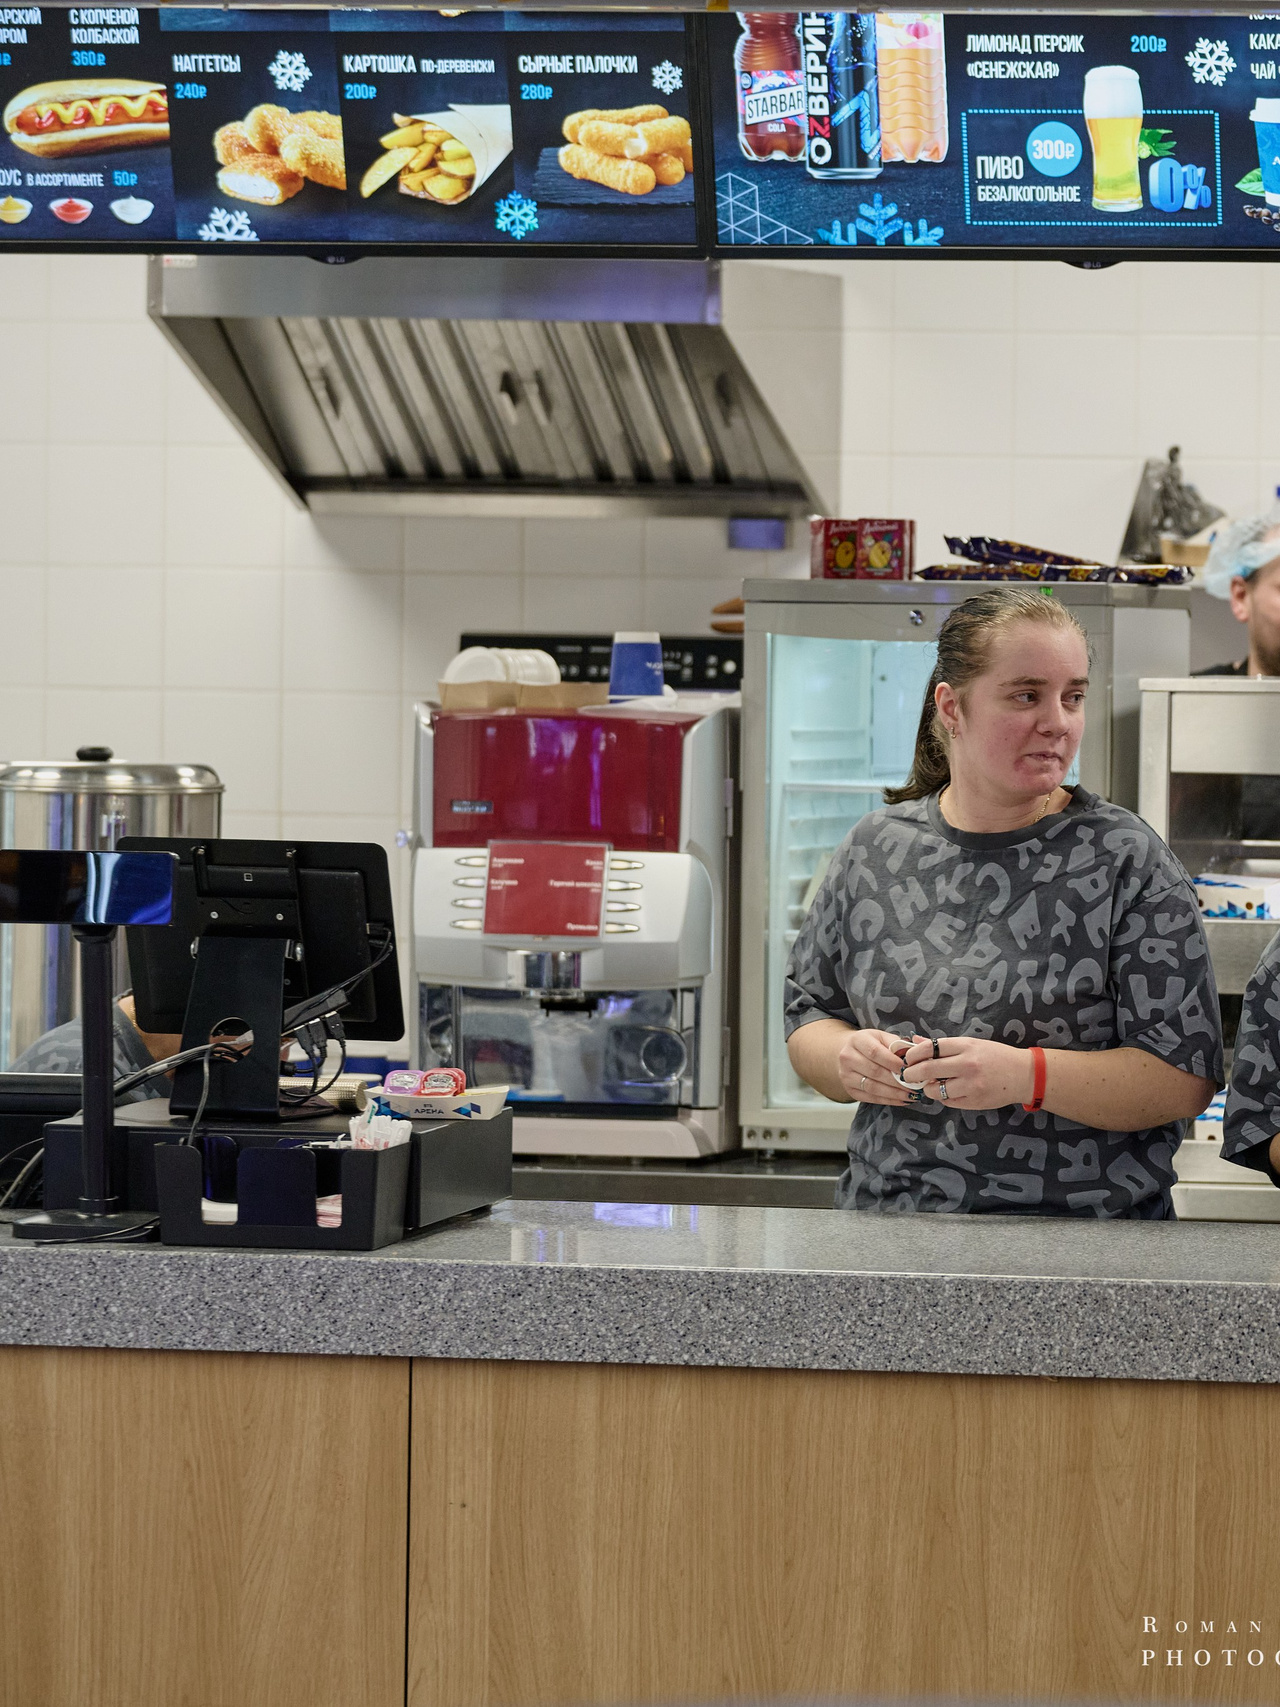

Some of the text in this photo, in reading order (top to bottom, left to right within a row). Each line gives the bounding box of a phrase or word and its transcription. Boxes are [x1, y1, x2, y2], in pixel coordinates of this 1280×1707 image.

[69, 7, 140, 25] С КОПЧЕНОЙ
[71, 26, 140, 44] КОЛБАСКОЙ
[966, 35, 1031, 55] ЛИМОНАД
[1033, 35, 1084, 53] ПЕРСИК
[173, 54, 241, 73] НАГГЕТСЫ
[343, 55, 495, 74] КАРТОШКА ПО-ДЕРЕВЕНСКИ
[518, 55, 638, 74] СЫРНЫЕ ПАЛОЧКИ
[967, 61, 1059, 79] «СЕНЕЖСКАЯ»
[1250, 61, 1276, 80] ЧАЙ
[747, 90, 804, 119] STARBAR
[767, 123, 787, 132] COLA
[976, 156, 1024, 180] ПИВО
[26, 173, 35, 187] В
[35, 172, 104, 187] АССОРТИМЕНТЕ
[1149, 158, 1211, 213] 0%
[977, 186, 1081, 202] БЕЗАЛКОГОЛЬНОЕ
